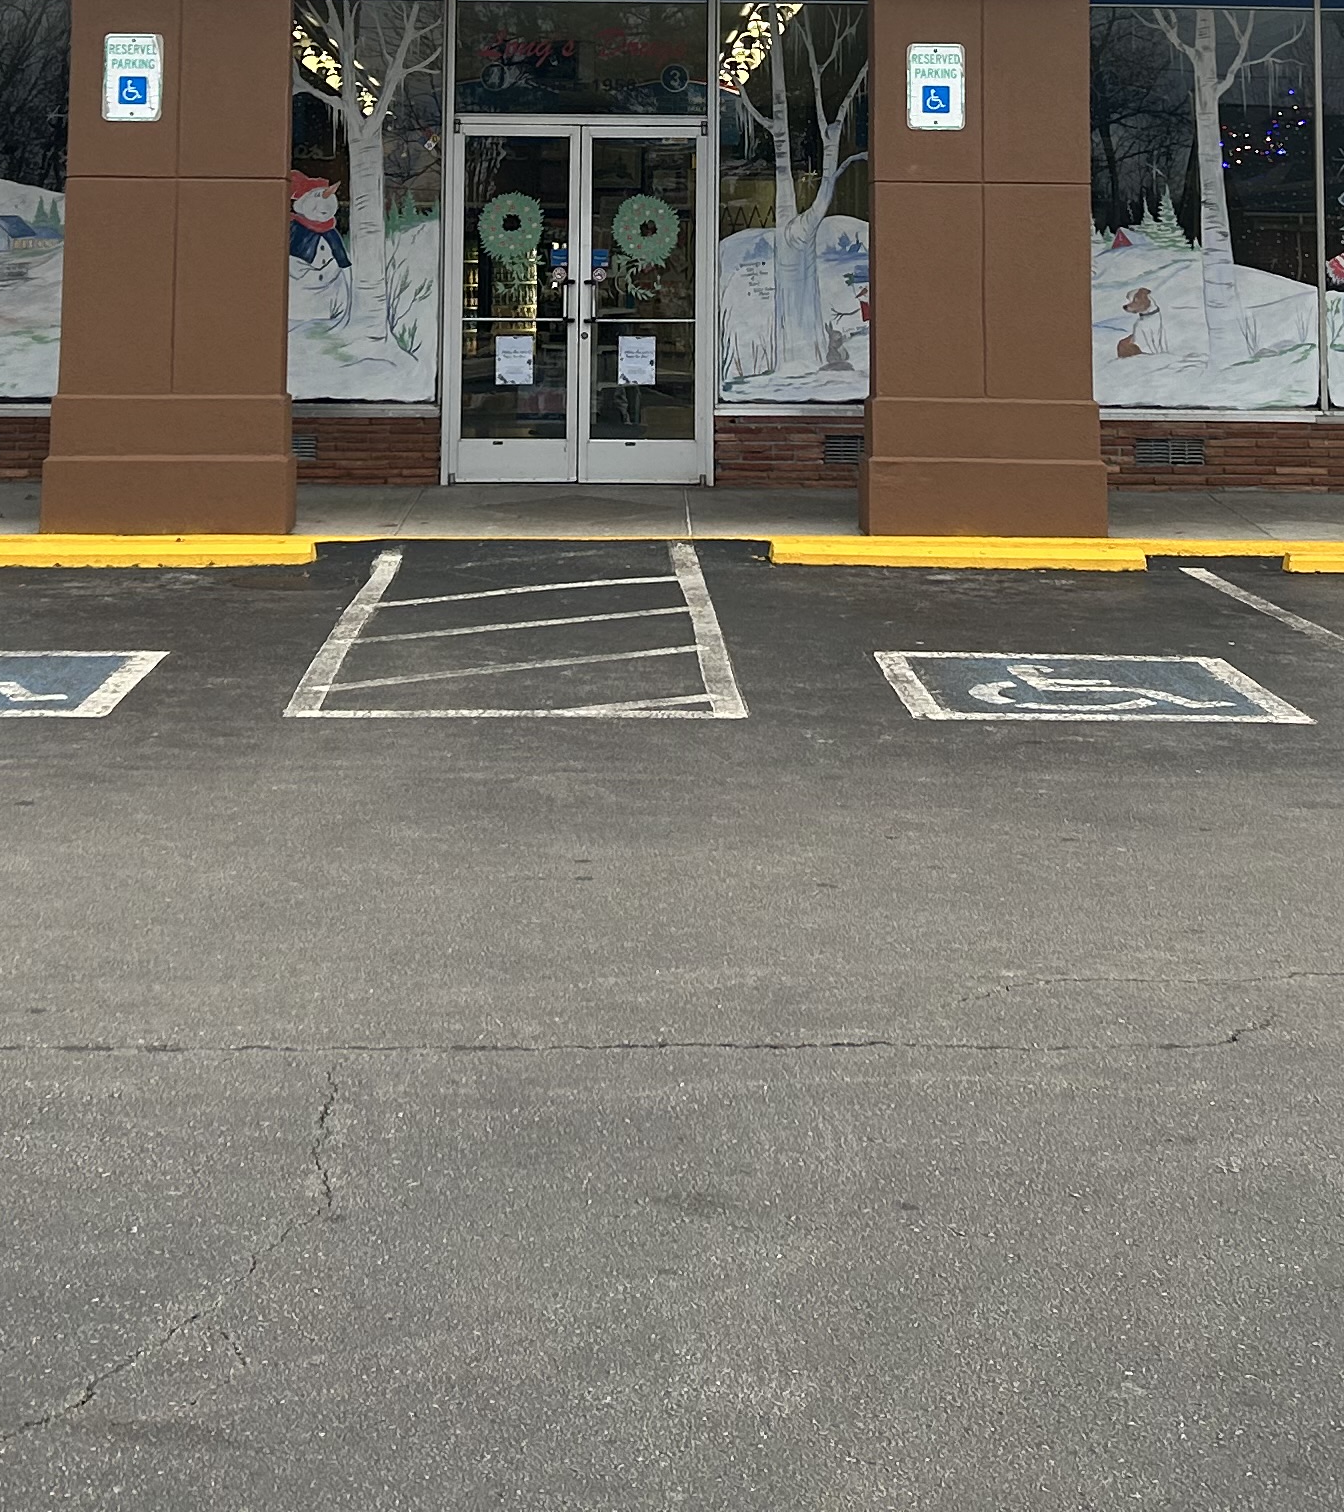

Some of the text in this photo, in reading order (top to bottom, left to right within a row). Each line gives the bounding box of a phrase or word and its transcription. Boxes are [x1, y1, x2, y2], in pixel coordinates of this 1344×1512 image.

[111, 59, 155, 69] PARKING
[912, 54, 960, 64] RESERVED
[915, 68, 957, 78] PARKING
